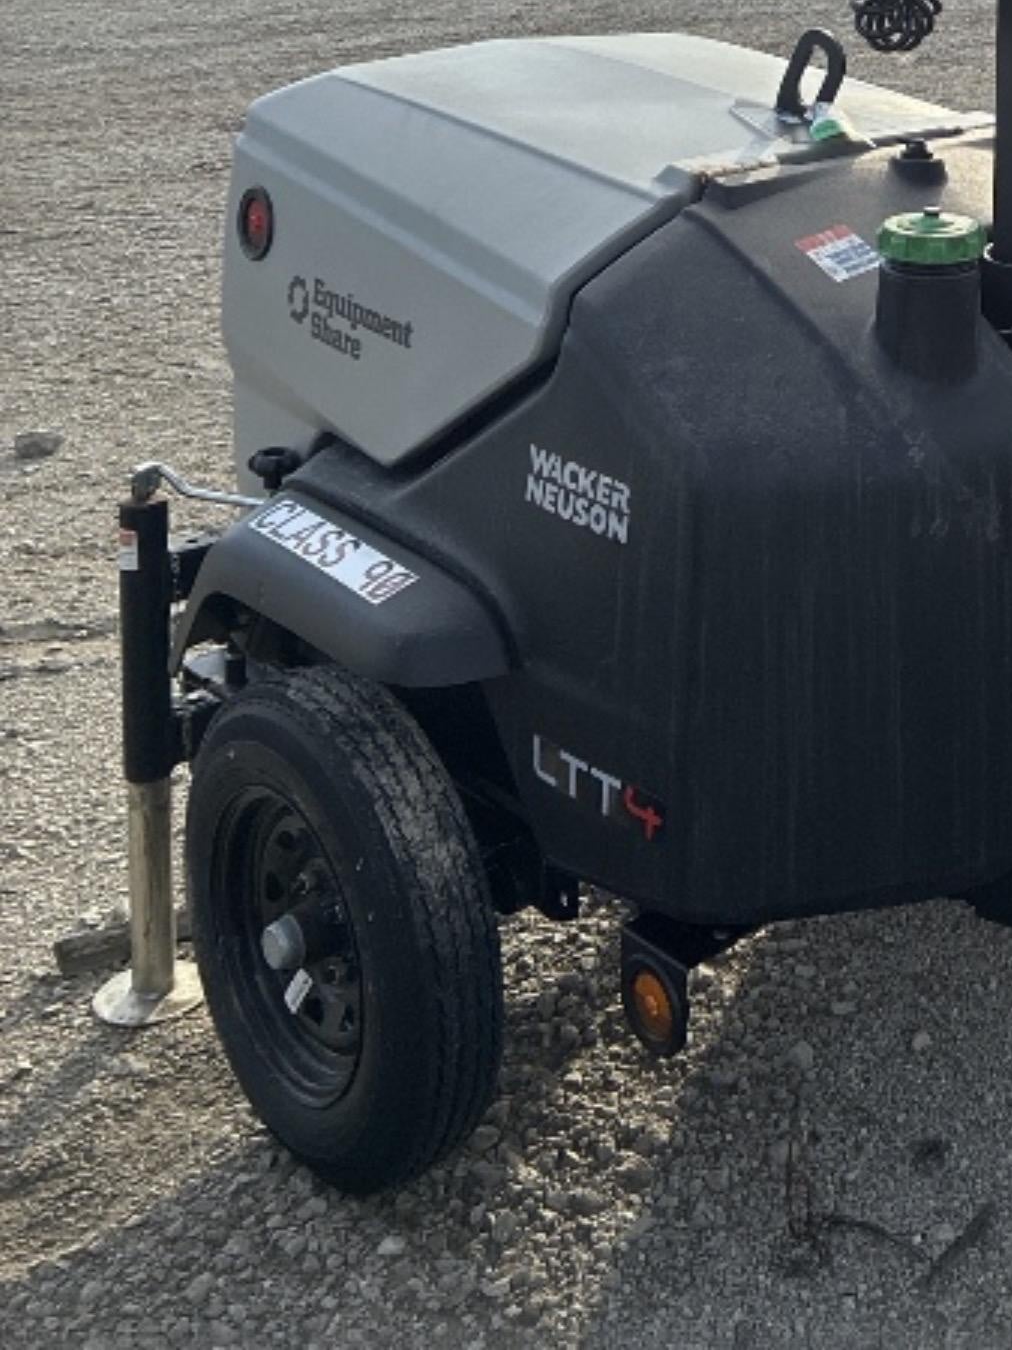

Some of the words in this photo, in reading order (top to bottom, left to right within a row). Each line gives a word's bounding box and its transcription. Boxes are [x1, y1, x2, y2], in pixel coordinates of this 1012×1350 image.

[311, 311, 362, 360] Share
[313, 277, 414, 349] Equipment
[525, 472, 629, 545] NEUSON
[530, 443, 631, 515] WACKER
[255, 502, 361, 568] CLASS
[532, 734, 664, 841] LTT4
